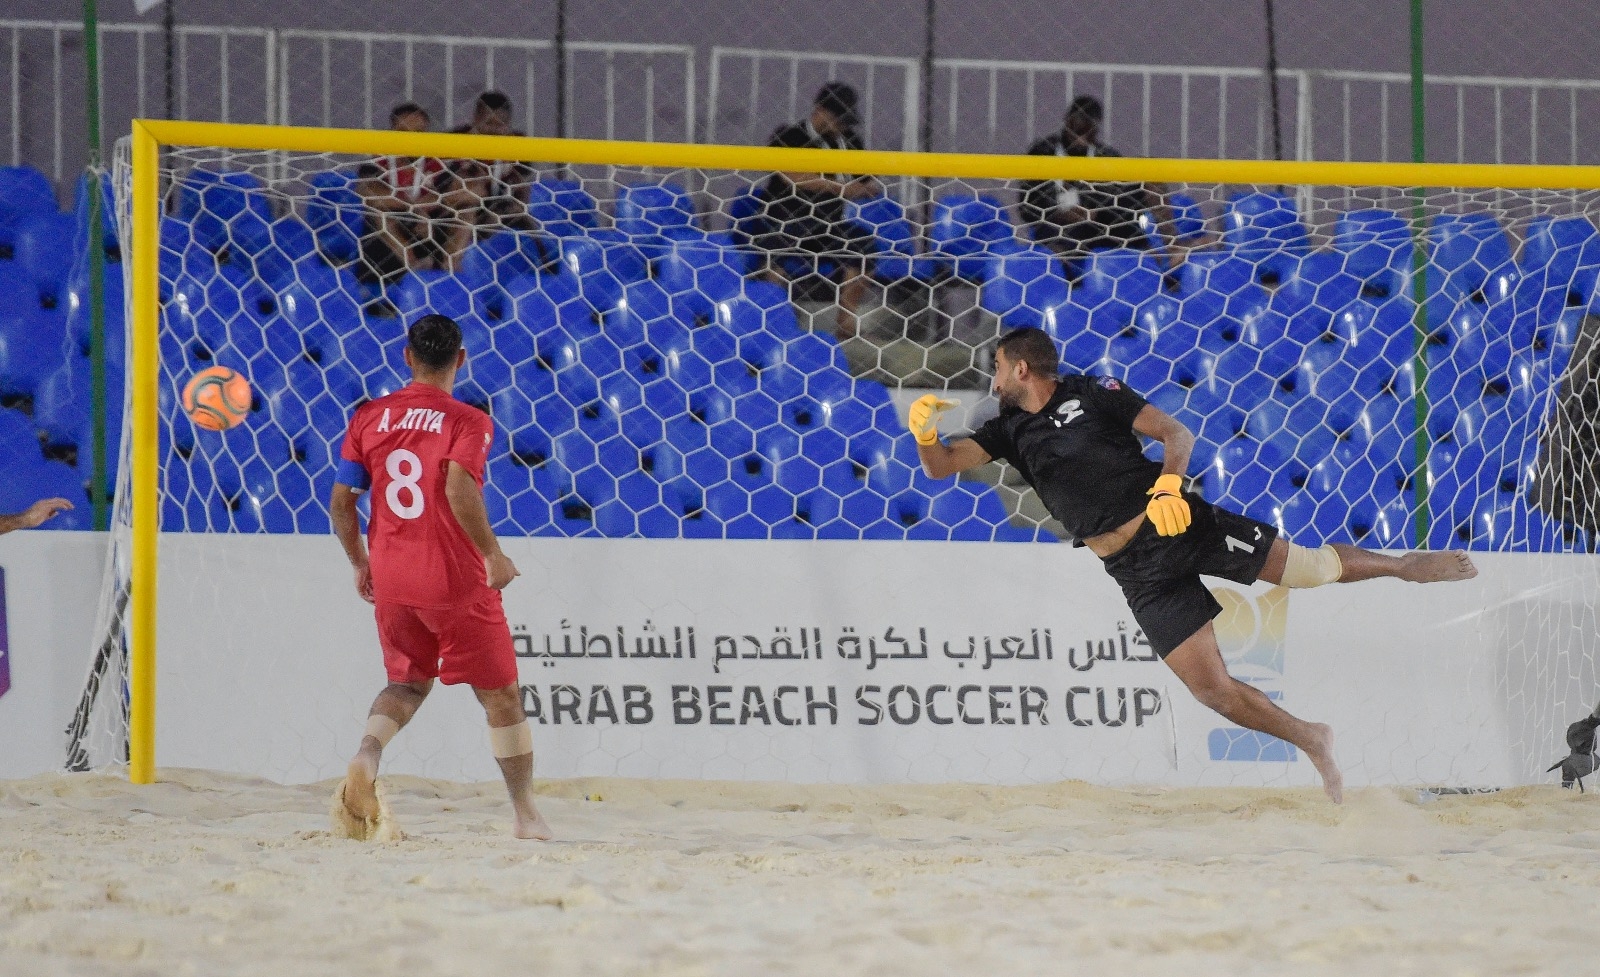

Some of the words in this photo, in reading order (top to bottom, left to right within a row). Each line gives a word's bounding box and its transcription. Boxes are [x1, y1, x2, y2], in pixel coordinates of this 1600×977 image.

[385, 448, 425, 520] 8
[511, 618, 697, 668] الشاطئية
[711, 626, 823, 674] القدم
[837, 625, 928, 670] لكرة
[943, 627, 1054, 669] العرب
[1068, 620, 1159, 672] كأس
[519, 684, 655, 725] ARAB
[671, 684, 838, 726] BEACH
[855, 684, 1050, 726] SOCCER
[1065, 685, 1163, 727] CUP
